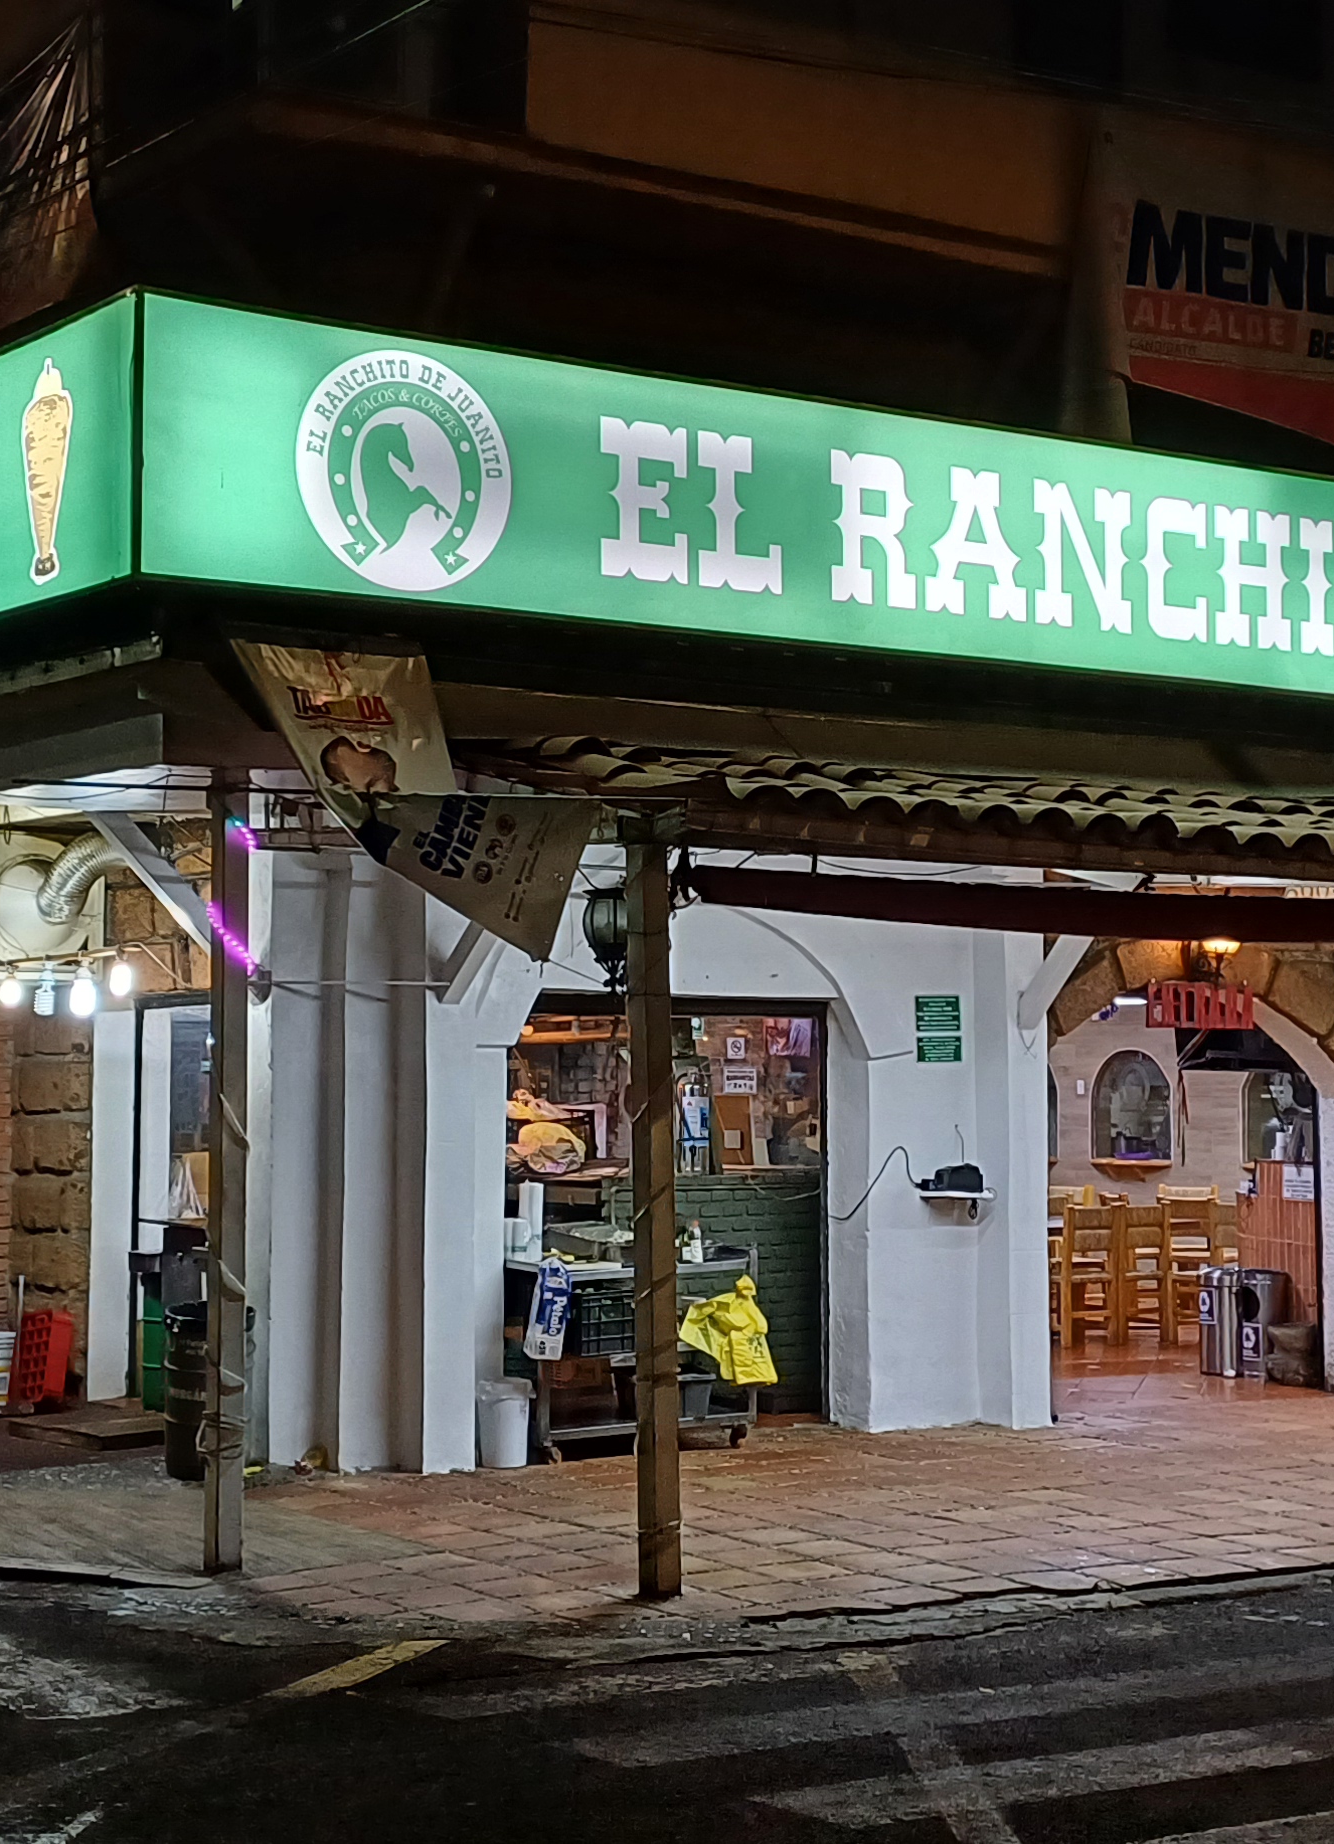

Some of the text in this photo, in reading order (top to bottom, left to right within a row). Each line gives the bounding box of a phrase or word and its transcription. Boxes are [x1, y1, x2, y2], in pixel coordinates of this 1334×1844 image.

[1133, 297, 1286, 346] ALCALDE
[306, 359, 503, 480] EL RANCHITO DE JUANITO
[352, 388, 463, 438] TACOS & CORTES
[600, 415, 783, 596] EL
